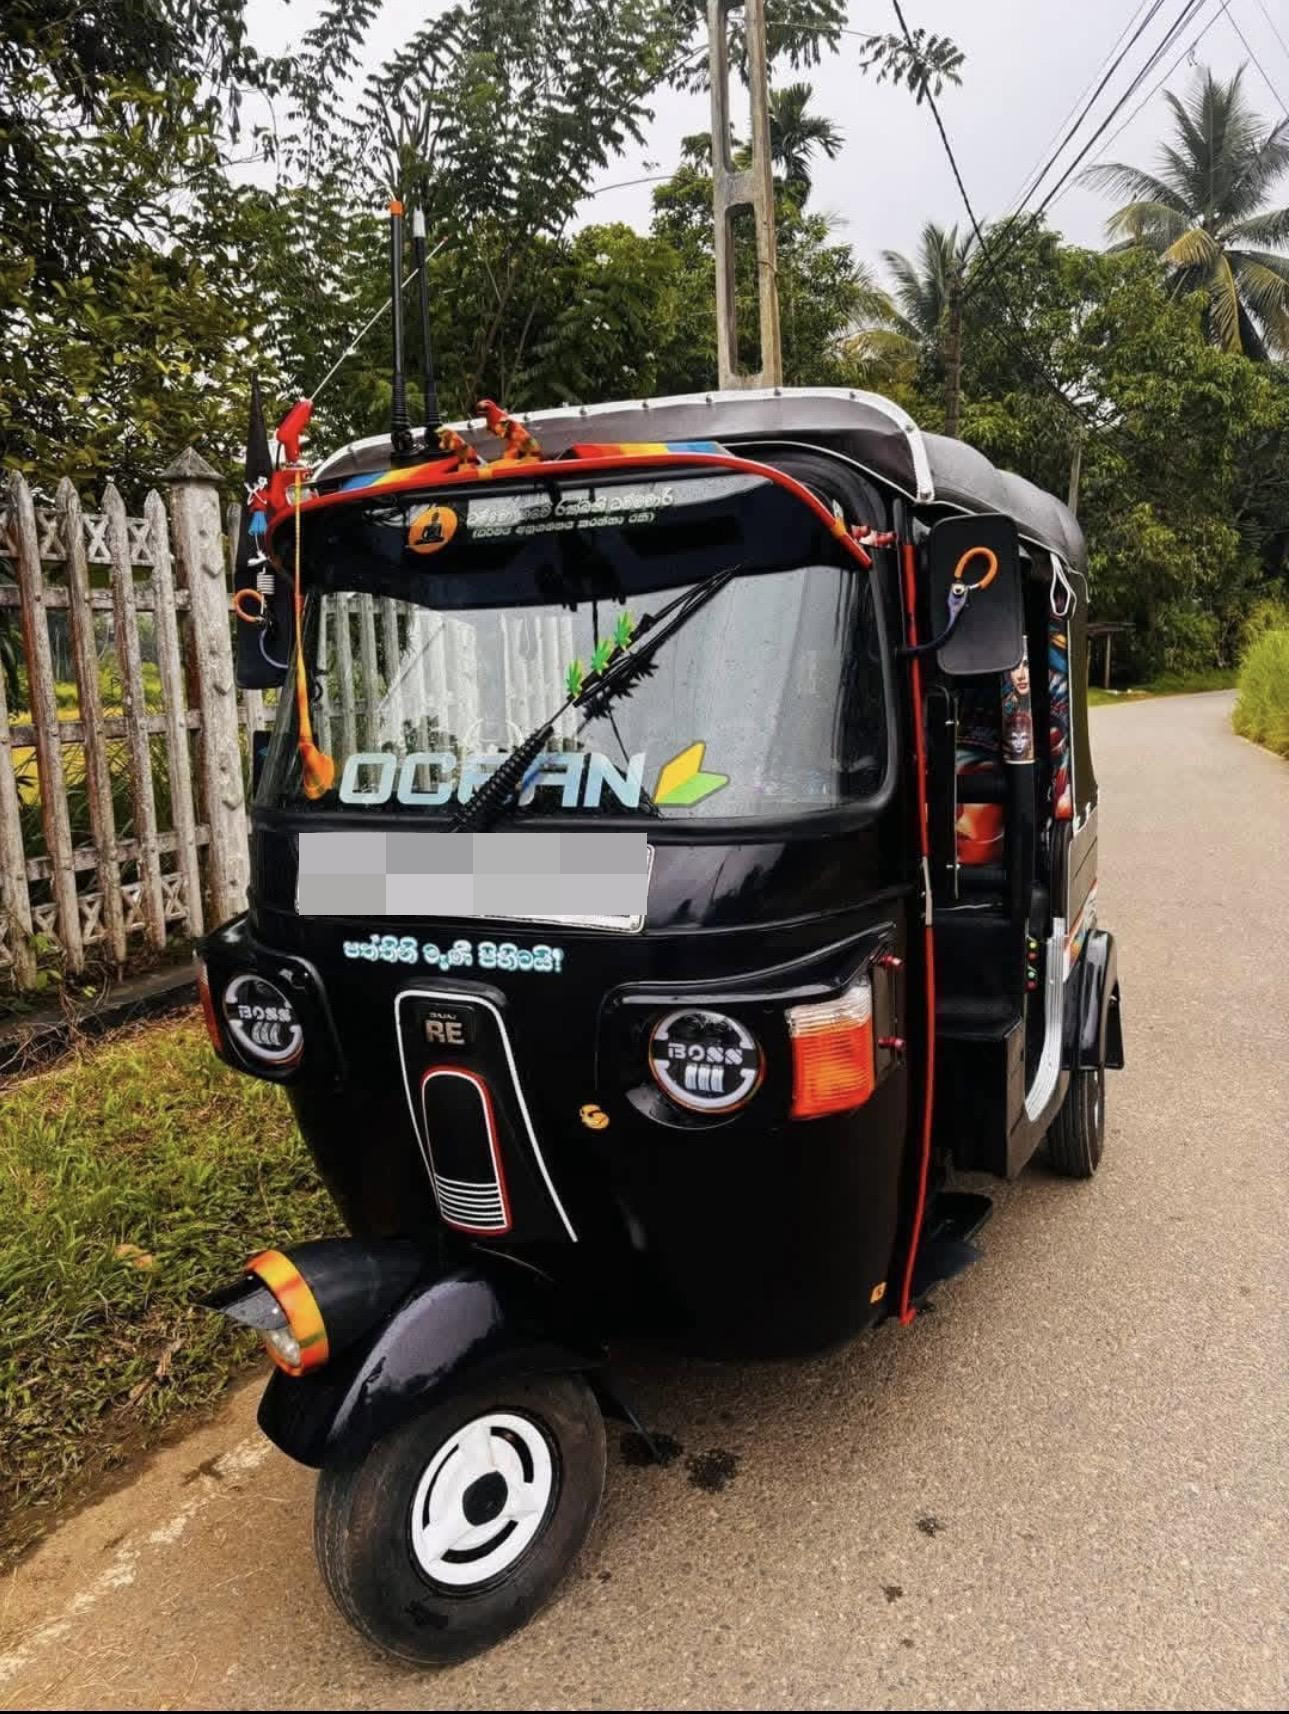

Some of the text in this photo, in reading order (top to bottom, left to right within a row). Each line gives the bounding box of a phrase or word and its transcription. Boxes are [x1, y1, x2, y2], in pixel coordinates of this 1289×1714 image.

[238, 1004, 292, 1023] BOSS
[425, 1019, 465, 1045] RE
[667, 1042, 744, 1065] BOSS
